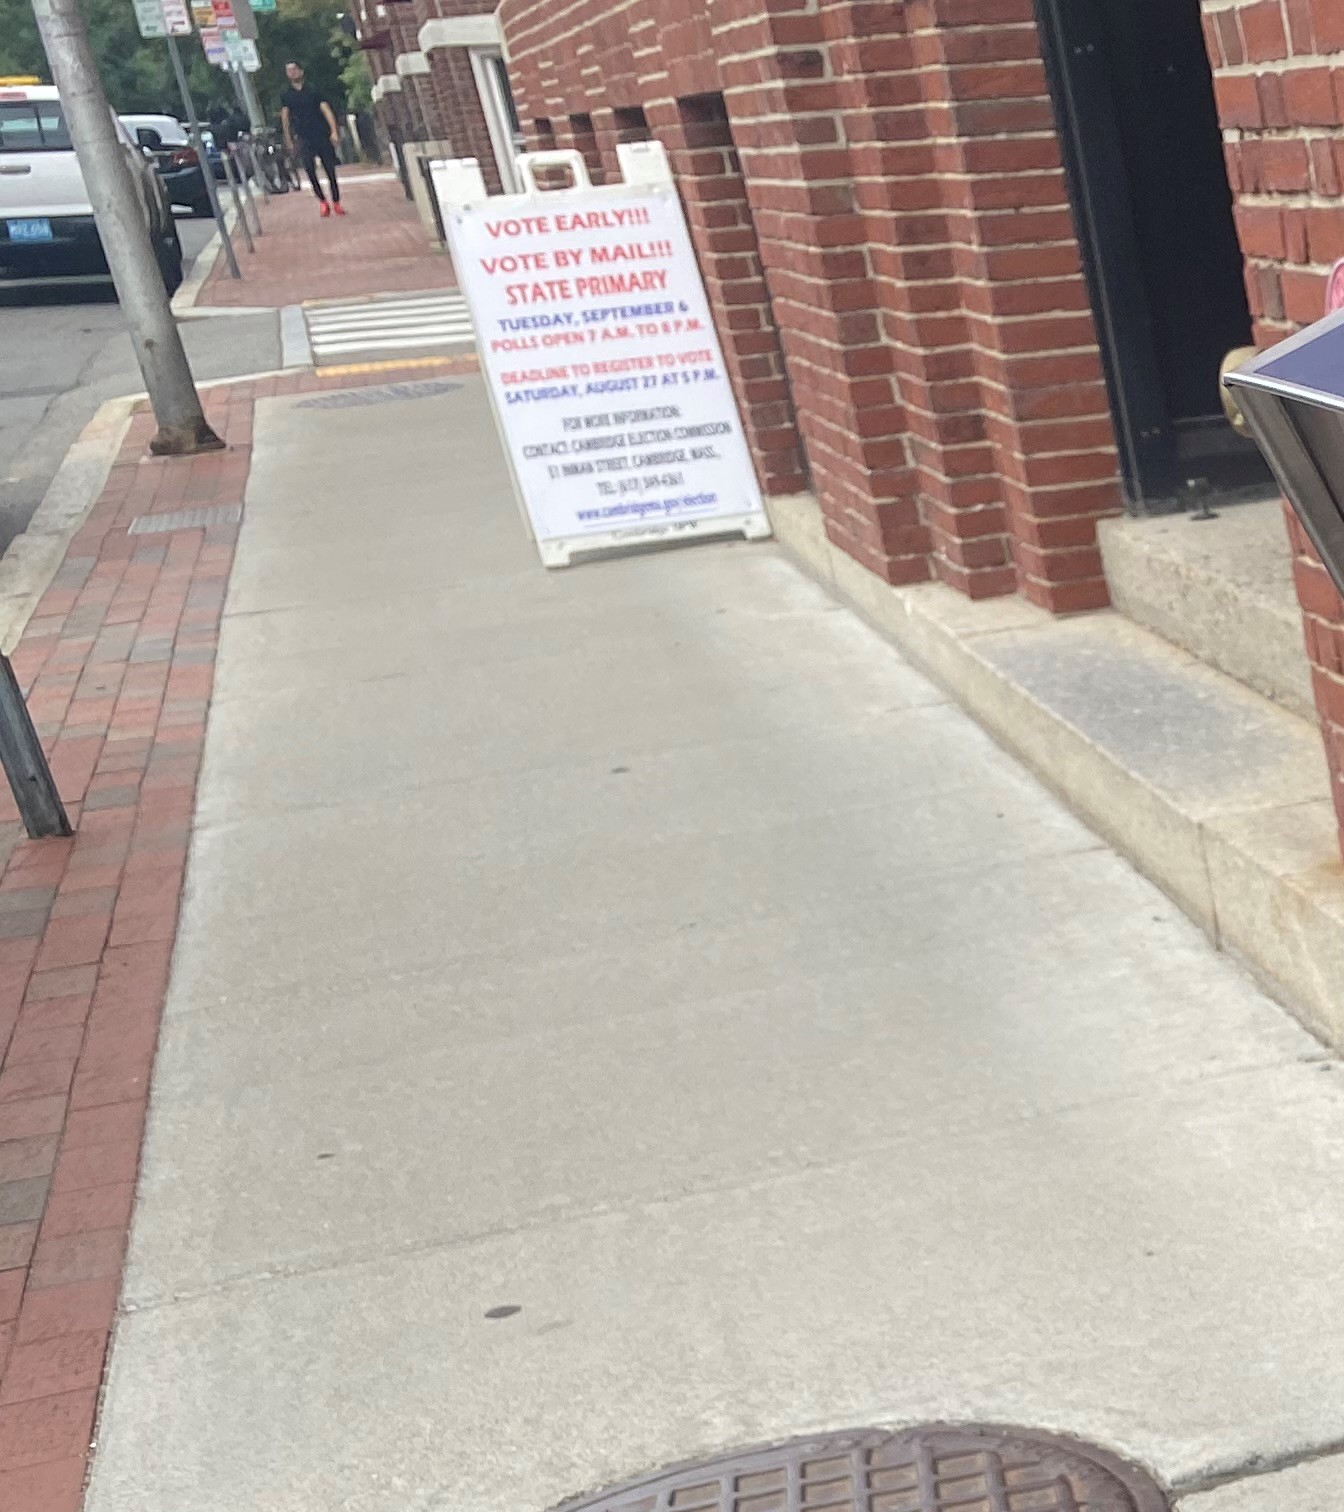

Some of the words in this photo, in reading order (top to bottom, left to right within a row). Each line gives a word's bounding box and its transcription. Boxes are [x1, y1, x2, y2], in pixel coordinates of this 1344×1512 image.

[485, 216, 550, 239] VOTE
[555, 207, 650, 232] EARLY!!!
[479, 252, 549, 275] VOTE
[553, 248, 583, 267] BY
[590, 240, 673, 263] MAIL!!!
[505, 279, 571, 305] STATE
[575, 269, 668, 298] PRIMARY
[498, 312, 580, 332] TUESDAY,
[581, 301, 674, 324] SEPTEMBER
[678, 300, 689, 312] 6
[490, 335, 538, 353] POLLS
[541, 330, 584, 348] OPEN
[588, 329, 597, 342] 7
[602, 325, 633, 341] A.M.
[635, 322, 658, 336] TO
[501, 367, 570, 386] DEADLINE
[571, 362, 591, 378] TO
[591, 354, 654, 375] REGISTER
[656, 352, 676, 367] TO
[677, 347, 712, 364] VOTE
[504, 382, 583, 405] SATURDAY,
[585, 376, 638, 396] AUGUST
[661, 371, 678, 386] AT
